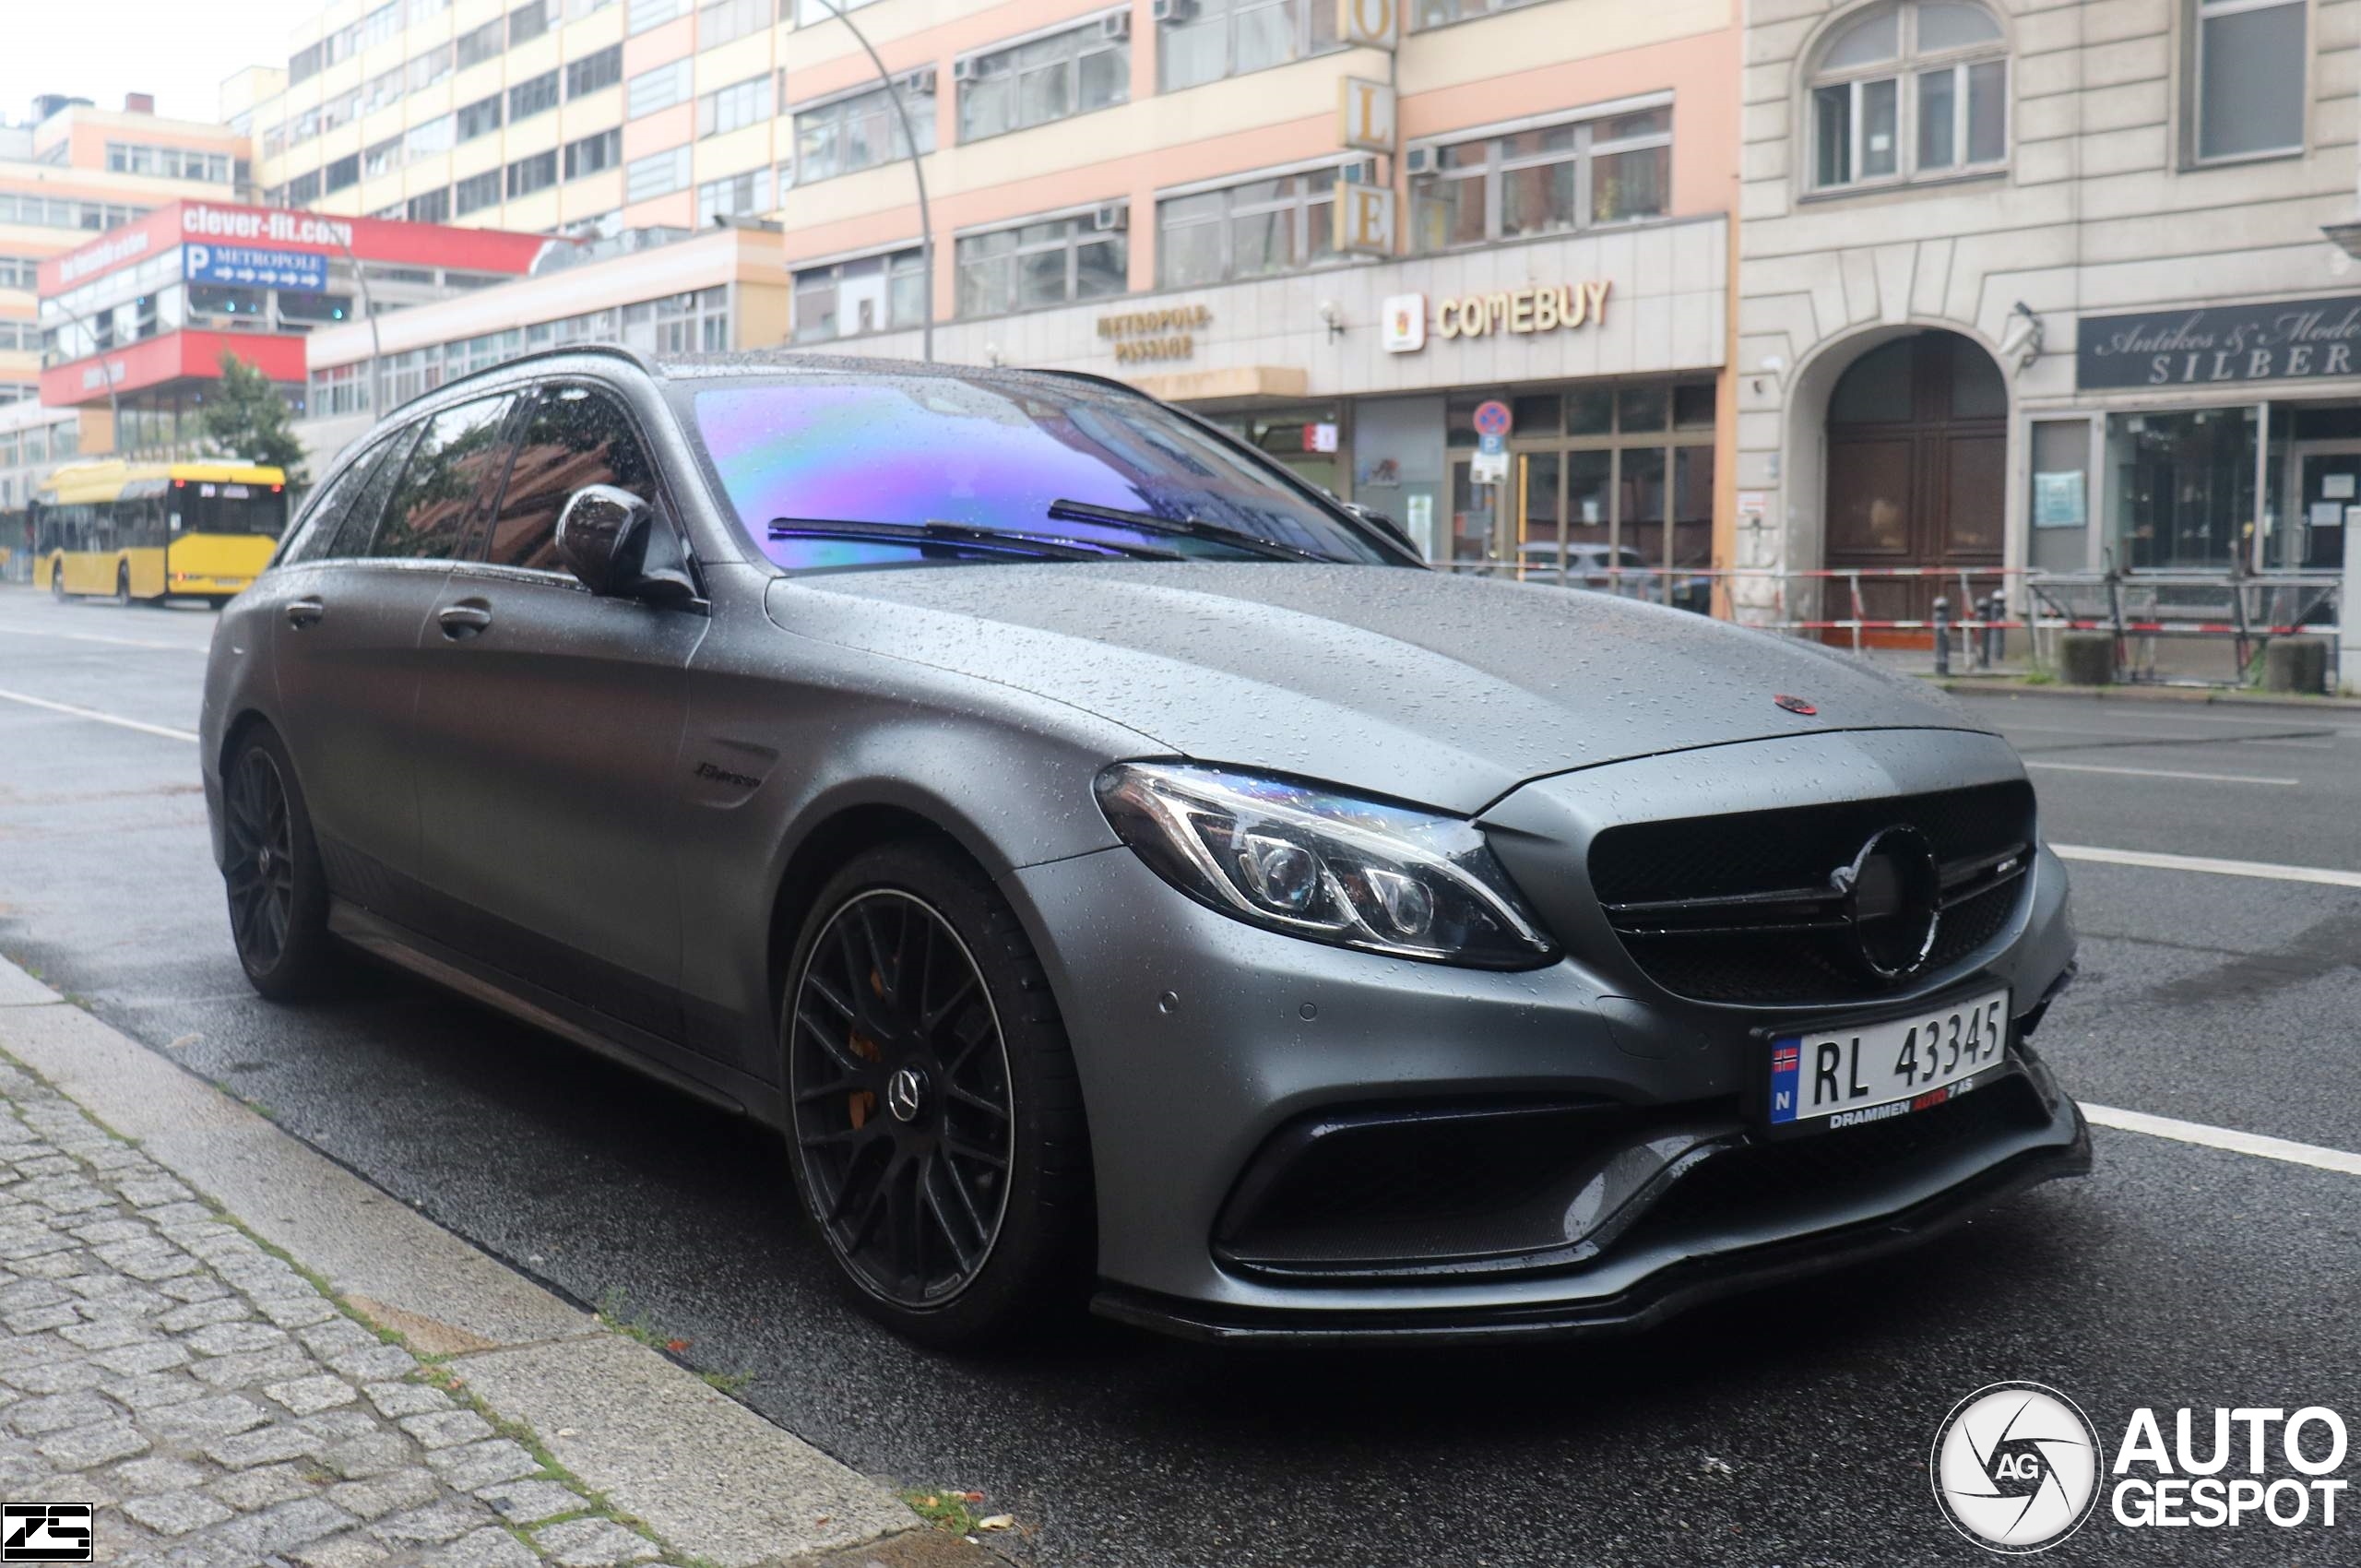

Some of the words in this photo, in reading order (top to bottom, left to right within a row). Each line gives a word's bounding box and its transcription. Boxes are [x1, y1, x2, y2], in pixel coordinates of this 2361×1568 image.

[184, 205, 352, 249] clever-fit.com
[186, 245, 209, 279] P
[216, 246, 321, 271] METROPOLE
[1437, 280, 1610, 340] COMEBUY
[2225, 323, 2259, 357] &
[2148, 343, 2351, 384] SILBER
[1813, 1038, 1869, 1105] RL
[1894, 1000, 2000, 1087] 43345
[1775, 1090, 1790, 1111] N
[1830, 1099, 1910, 1129] DRAMMEN
[1912, 1087, 1948, 1111] AUTO
